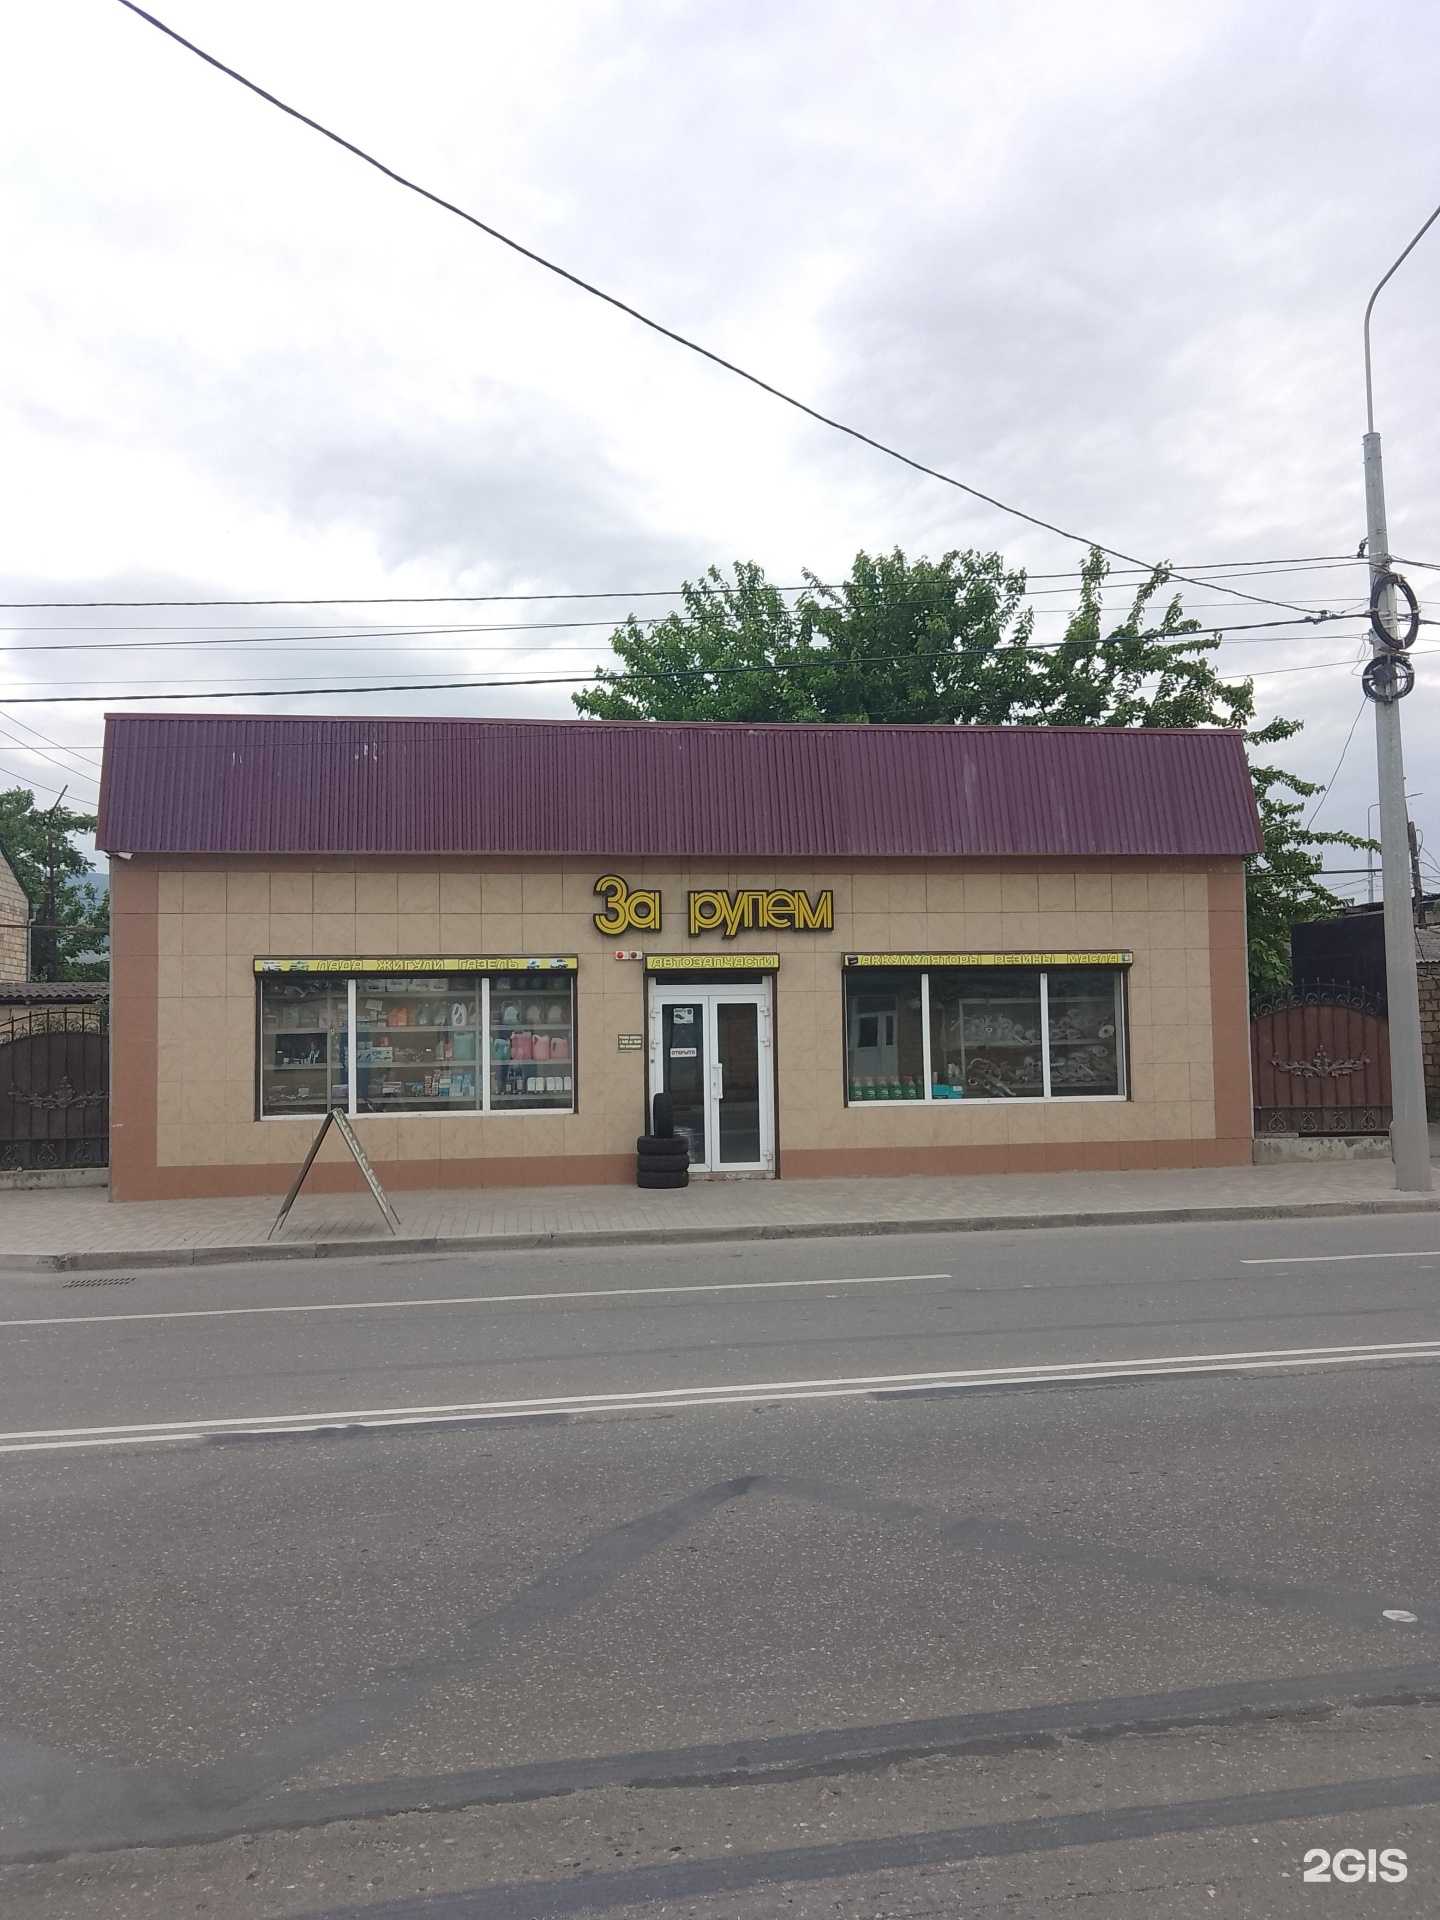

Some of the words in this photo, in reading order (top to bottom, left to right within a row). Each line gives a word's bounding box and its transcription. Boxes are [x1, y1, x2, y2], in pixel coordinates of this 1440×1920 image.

[593, 874, 661, 935] За
[316, 959, 364, 971] ЛАДА
[376, 959, 444, 971] ЖИГУЛИ
[458, 958, 520, 970] ГАЗЕЛЬ
[650, 956, 775, 969] АВТОЗАПЧАСТИ
[861, 954, 982, 966] АККУМУЛЯТОРЫ
